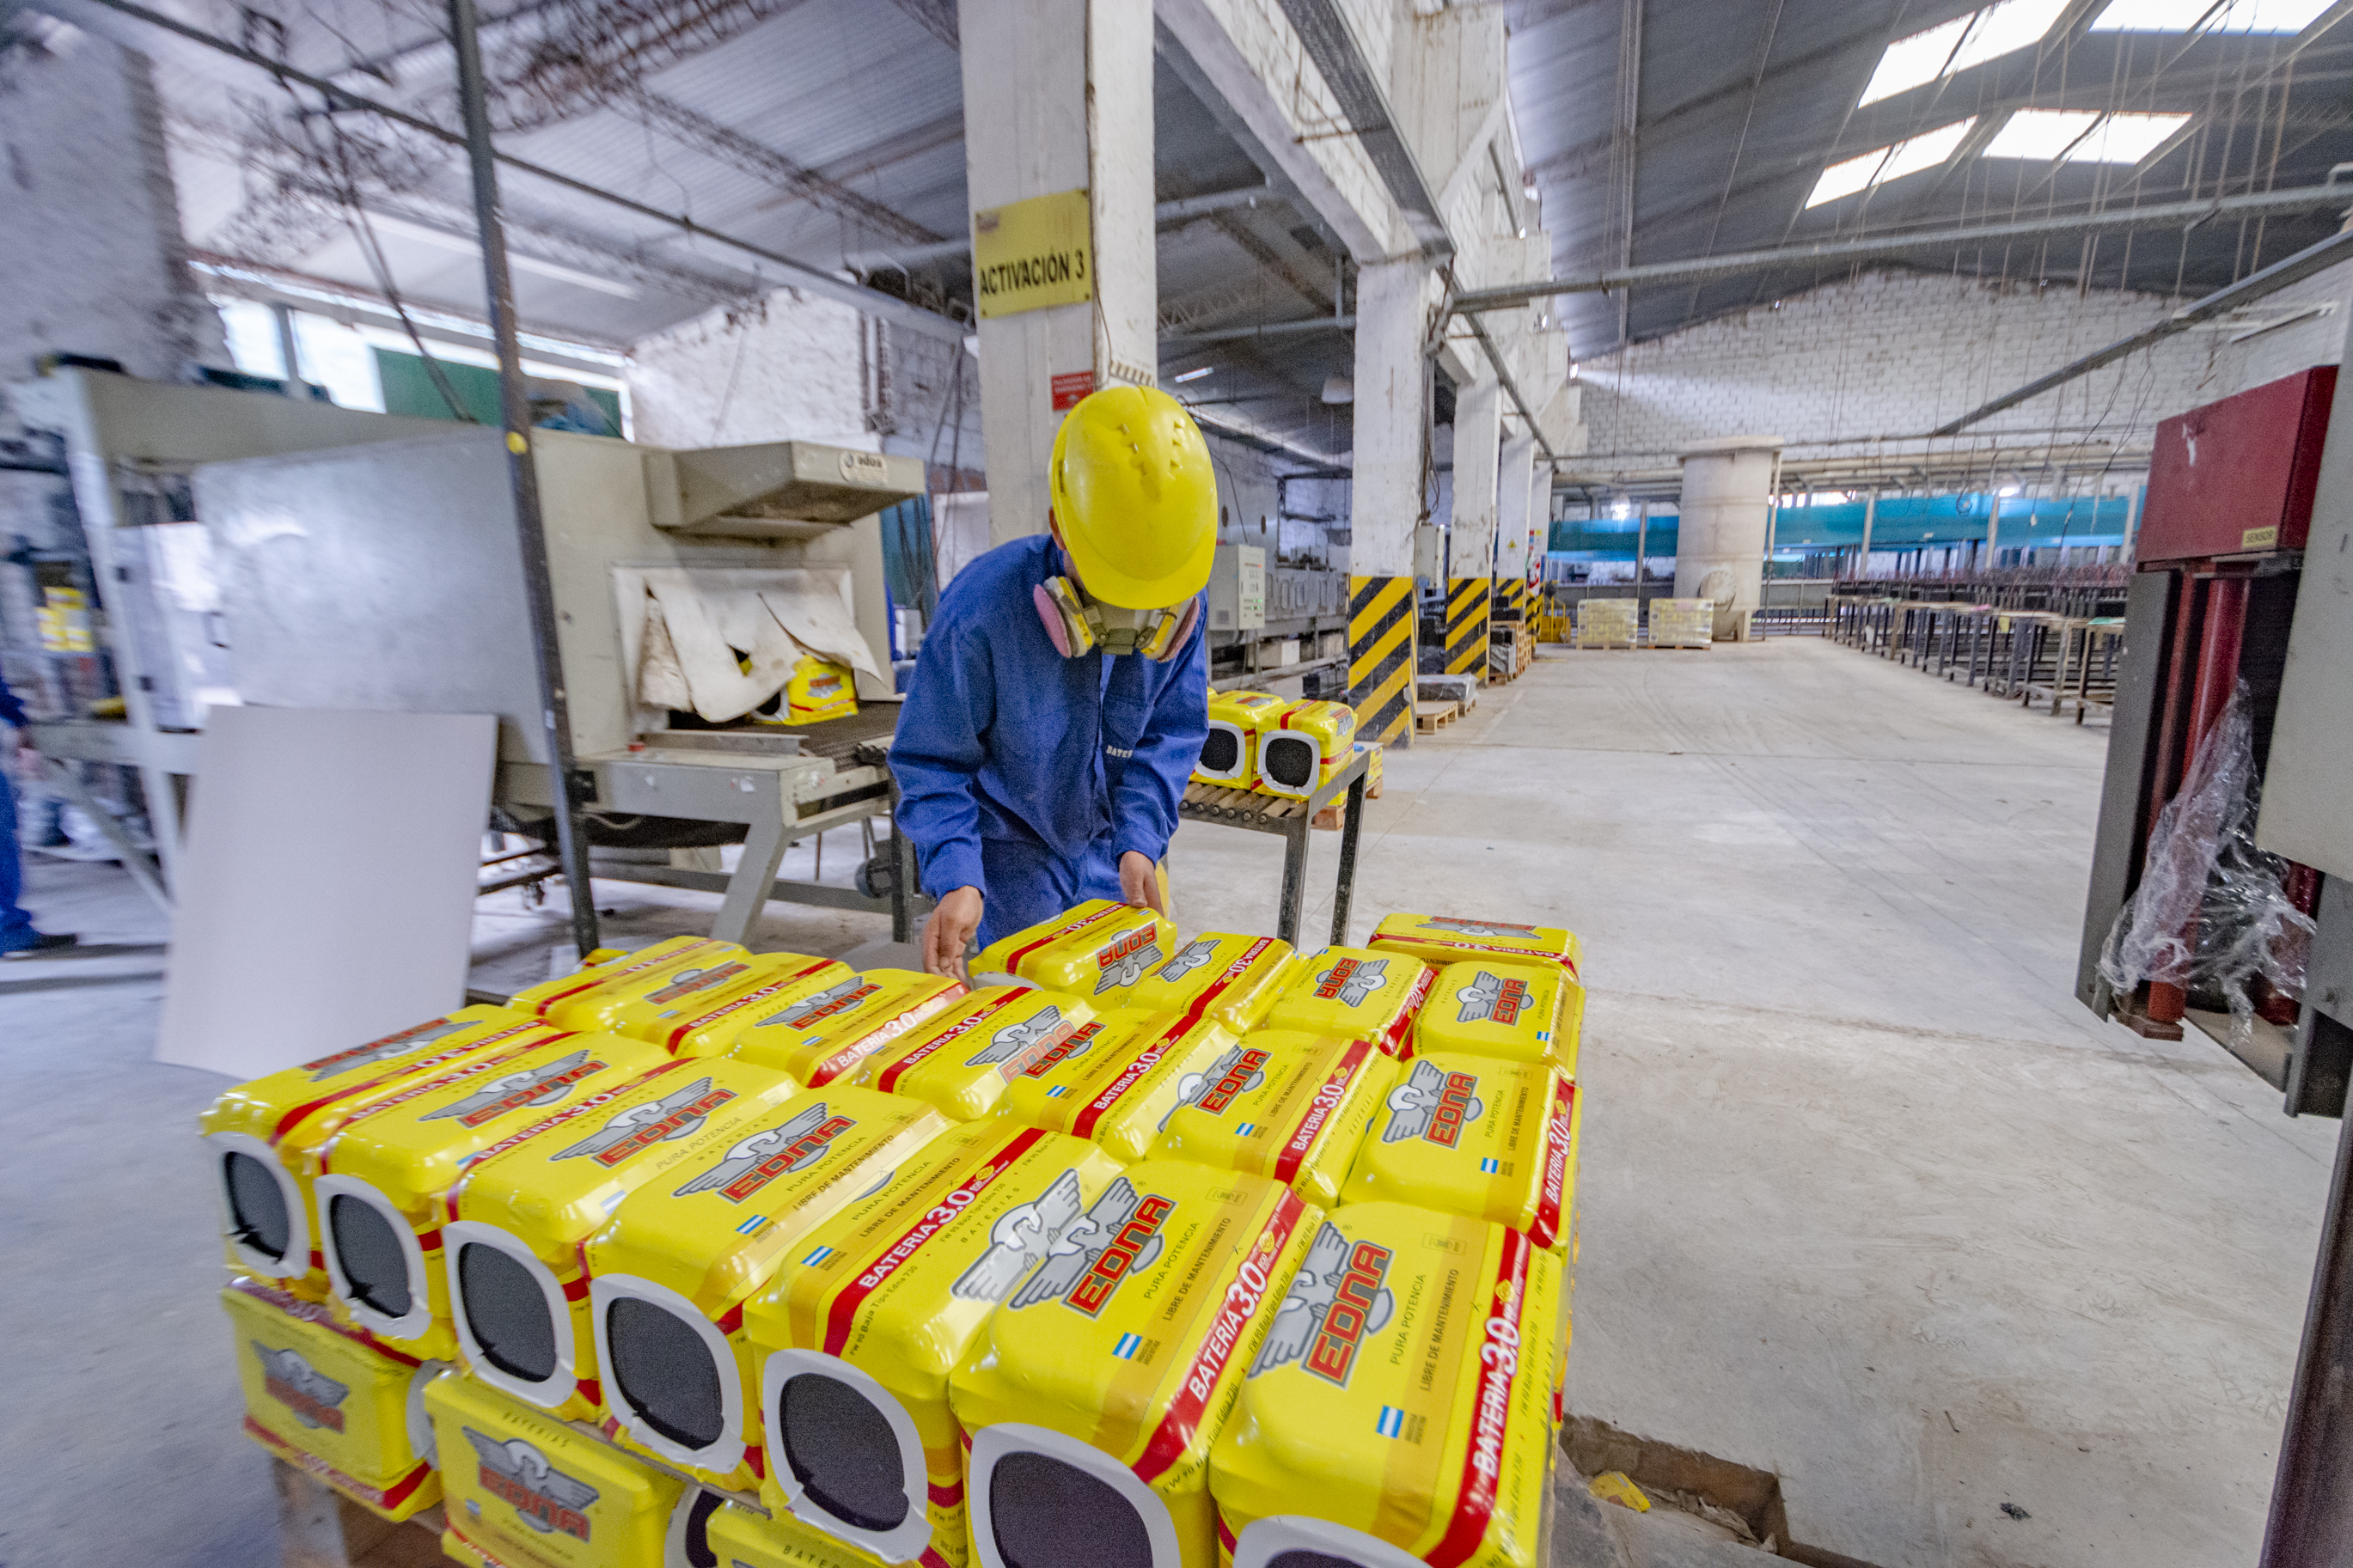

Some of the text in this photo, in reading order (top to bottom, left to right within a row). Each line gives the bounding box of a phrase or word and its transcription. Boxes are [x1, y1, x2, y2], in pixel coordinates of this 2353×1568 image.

[1076, 250, 1084, 279] 3
[1097, 923, 1157, 969] EDNA
[689, 999, 749, 1028] BATERIA
[743, 986, 779, 1003] 3.0
[790, 985, 881, 1029] EDNA
[1316, 958, 1360, 999] EDNA
[1491, 978, 1526, 1025] EDNA
[837, 1011, 917, 1067] BATERIA 3.0
[903, 1033, 957, 1065] BATERIA
[949, 1016, 983, 1035] 3.0
[1026, 1022, 1103, 1077] EDNA
[1072, 1035, 1119, 1071] PURA POTENCIA
[1083, 1068, 1099, 1081] LIBRE
[1104, 1033, 1140, 1065] MANTENIMIENTO
[464, 1061, 605, 1126] EDNA
[1093, 1072, 1140, 1110] BATERIA
[1128, 1052, 1161, 1074] 3.0
[1197, 1049, 1269, 1113] EDNA
[1253, 1089, 1268, 1106] PURA
[1266, 1064, 1289, 1091] POTENCIA
[1268, 1101, 1282, 1118] LIBRE
[1285, 1061, 1313, 1095] MANTENIMIENTO
[1424, 1073, 1476, 1148] EDNA
[1513, 1087, 1529, 1126] MANTENIMIENTO
[477, 1114, 570, 1160] BATERIA
[567, 1093, 614, 1120] 3.0
[596, 1089, 735, 1166] EDNA
[656, 1117, 743, 1170] PURA POTENCIA
[697, 1118, 769, 1161] BATERIAS
[1292, 1107, 1328, 1151] BATERIA
[1313, 1083, 1345, 1108] 3.0
[1485, 1089, 1505, 1138] PURA POTENCIA
[1507, 1134, 1519, 1151] LIBRE
[1512, 1124, 1520, 1135] DE
[722, 1116, 853, 1201] EDNA
[786, 1136, 867, 1192] PURA POTENCIA
[792, 1134, 895, 1211] LIBRE DE MANTENIMIENTO
[1545, 1118, 1571, 1205] BATERIA 3.0
[852, 1161, 932, 1221] PURA POTENCIA
[859, 1157, 961, 1238] LIBRE DE MANTENIMIENTO
[939, 1182, 1006, 1243] FW 90 Baja Tipo Edna 730
[960, 1187, 1020, 1244] BATERIAS
[859, 1189, 976, 1289] BATERIA 3.0
[1066, 1195, 1173, 1315] EDNA
[1143, 1222, 1200, 1300] PURA POTENCIA
[1162, 1217, 1232, 1321] LIBRE DE MANTENIMIENTO
[1297, 1239, 1306, 1252] FW
[849, 1266, 918, 1357] FW 90 Baja Tipo Edna 730
[1188, 1260, 1267, 1404] BATERIA 3.0
[1247, 1271, 1291, 1355] FW 90 Baja Tipo Edna 730
[1305, 1242, 1390, 1383] EDNA
[1390, 1273, 1427, 1366] PURA POTENCIA
[1420, 1268, 1459, 1393] LIBRE DE MANTENIMIENTO
[1481, 1317, 1521, 1377] 3.0
[1207, 1420, 1222, 1446] Tipo
[1216, 1398, 1233, 1425] Edna
[1225, 1382, 1238, 1402] 730
[1472, 1371, 1509, 1479] BATERIA
[480, 1465, 590, 1543] EDNA
